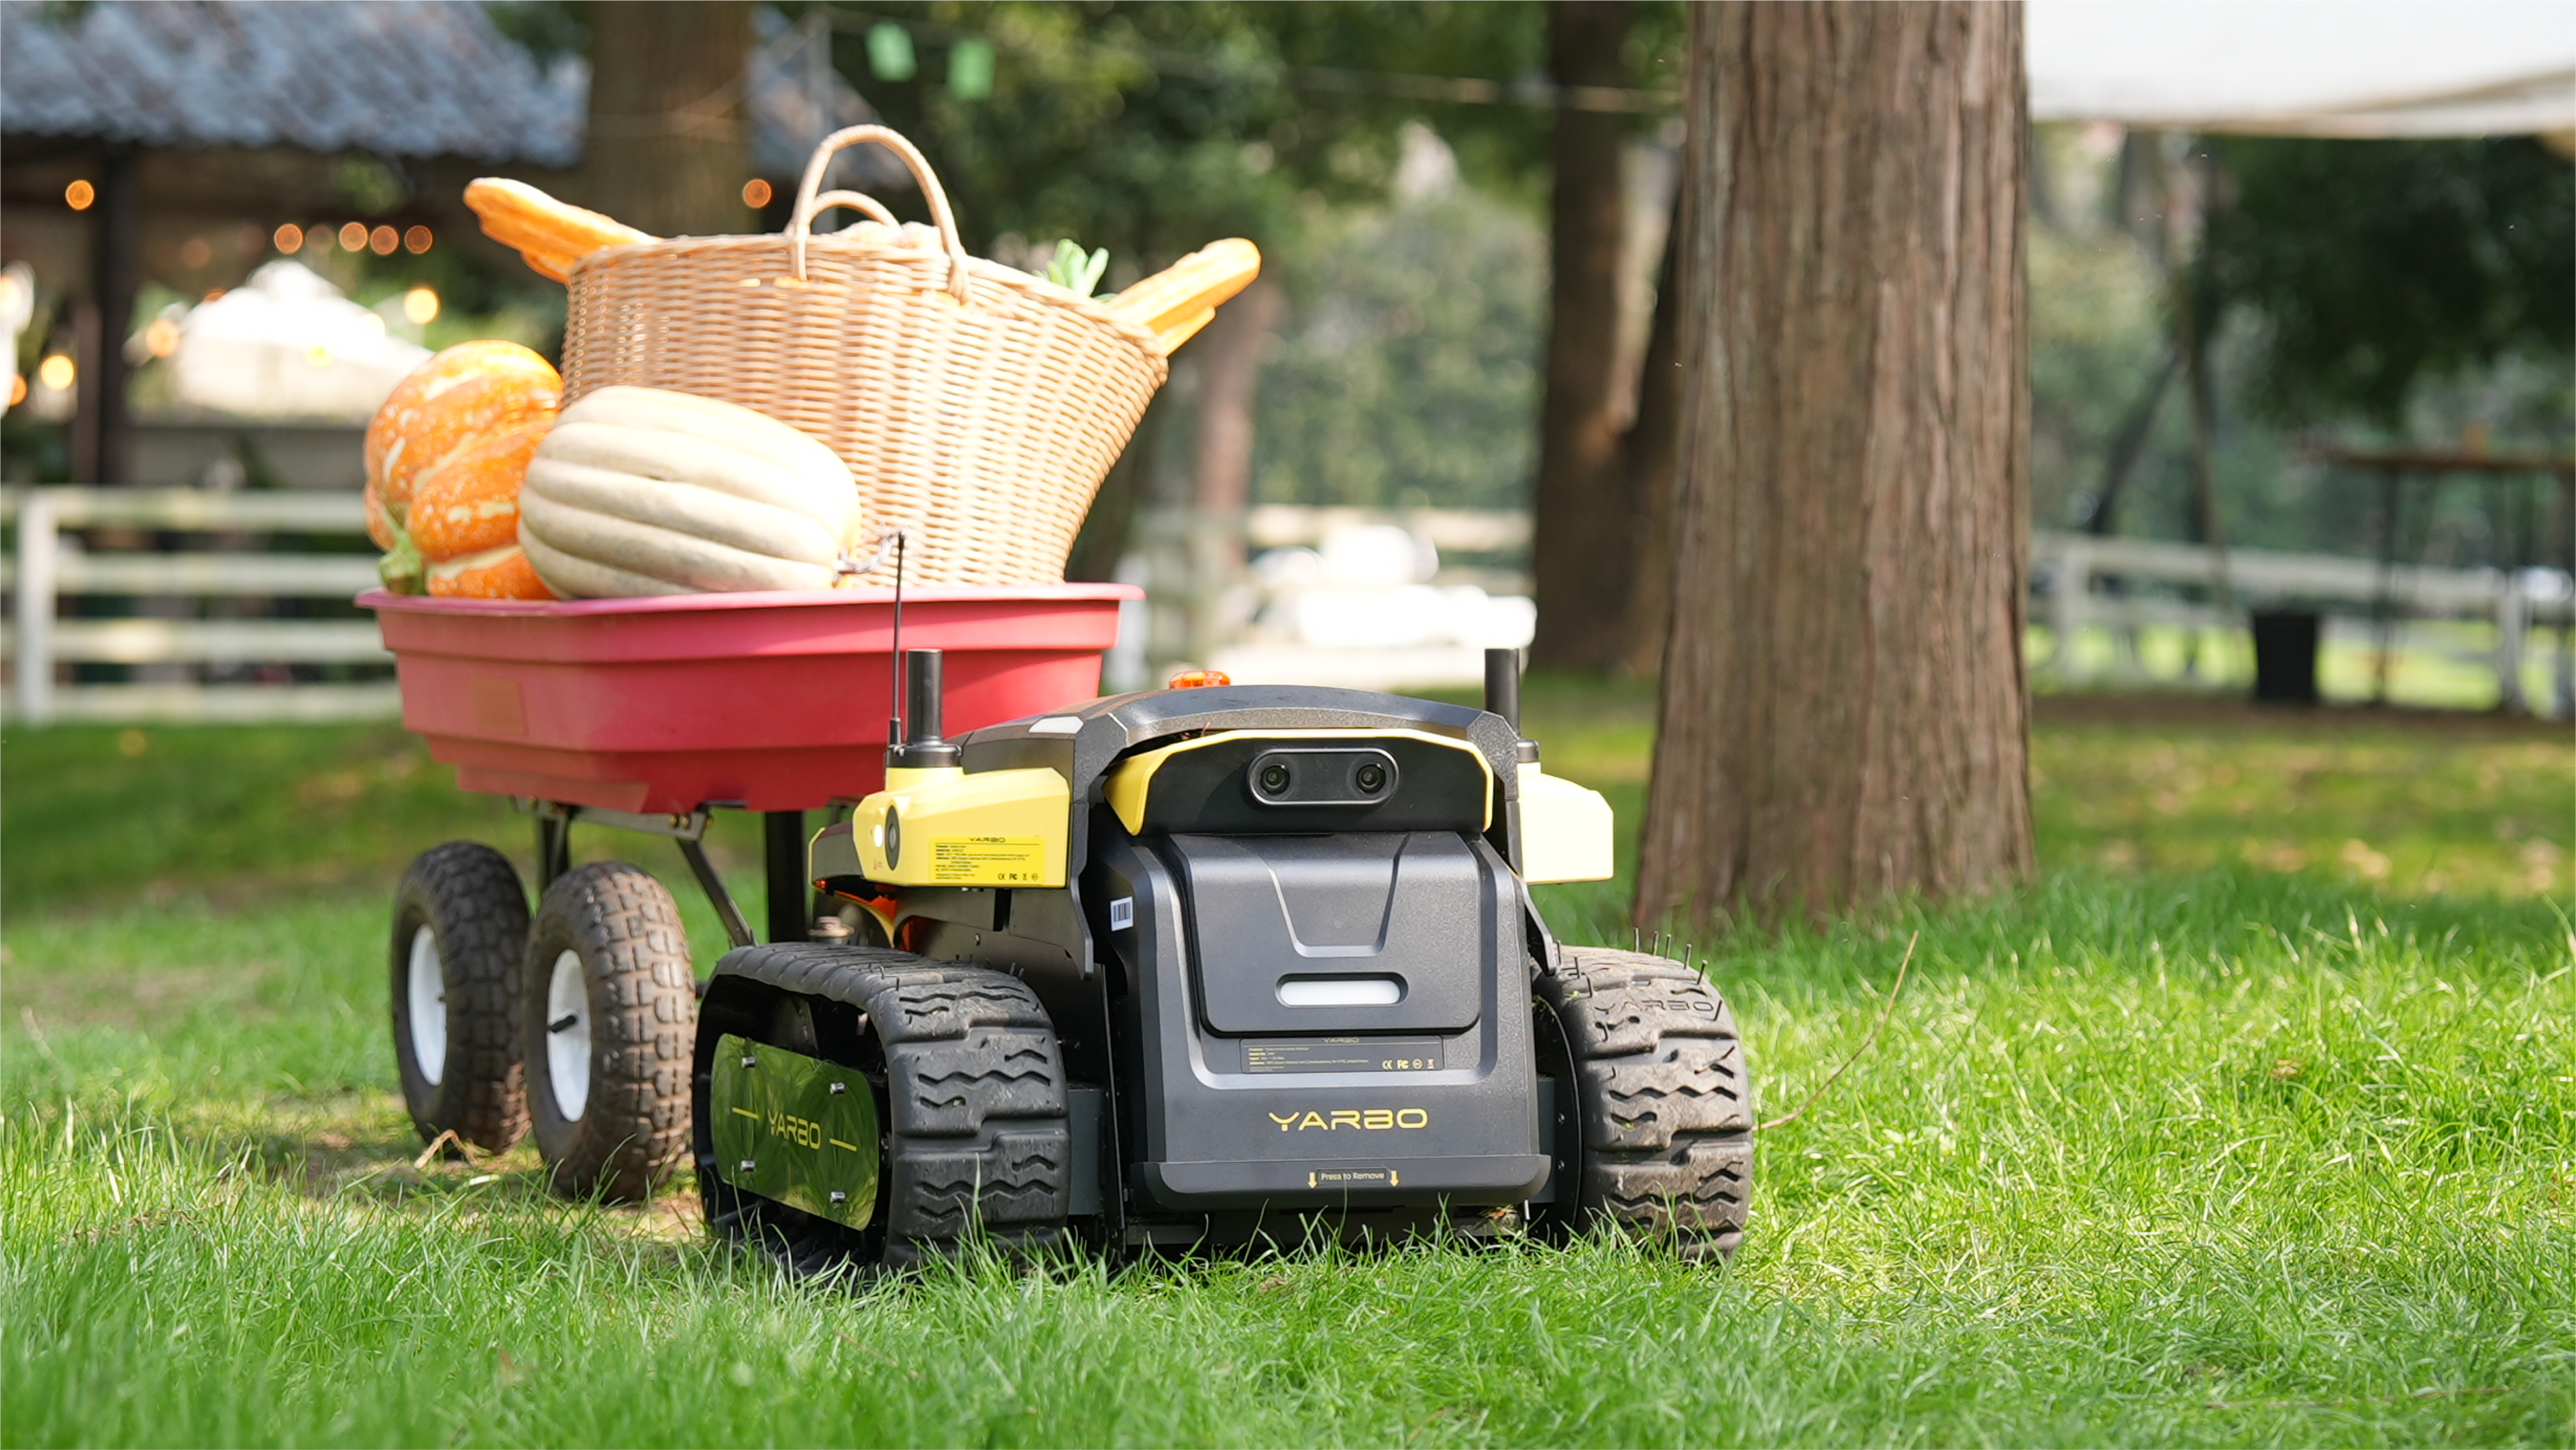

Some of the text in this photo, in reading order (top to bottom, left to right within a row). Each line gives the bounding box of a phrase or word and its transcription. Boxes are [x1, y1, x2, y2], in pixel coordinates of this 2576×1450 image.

[1594, 1001, 1713, 1015] YARBO
[767, 1109, 821, 1150] YARBO
[1269, 1108, 1428, 1131] YARBO
